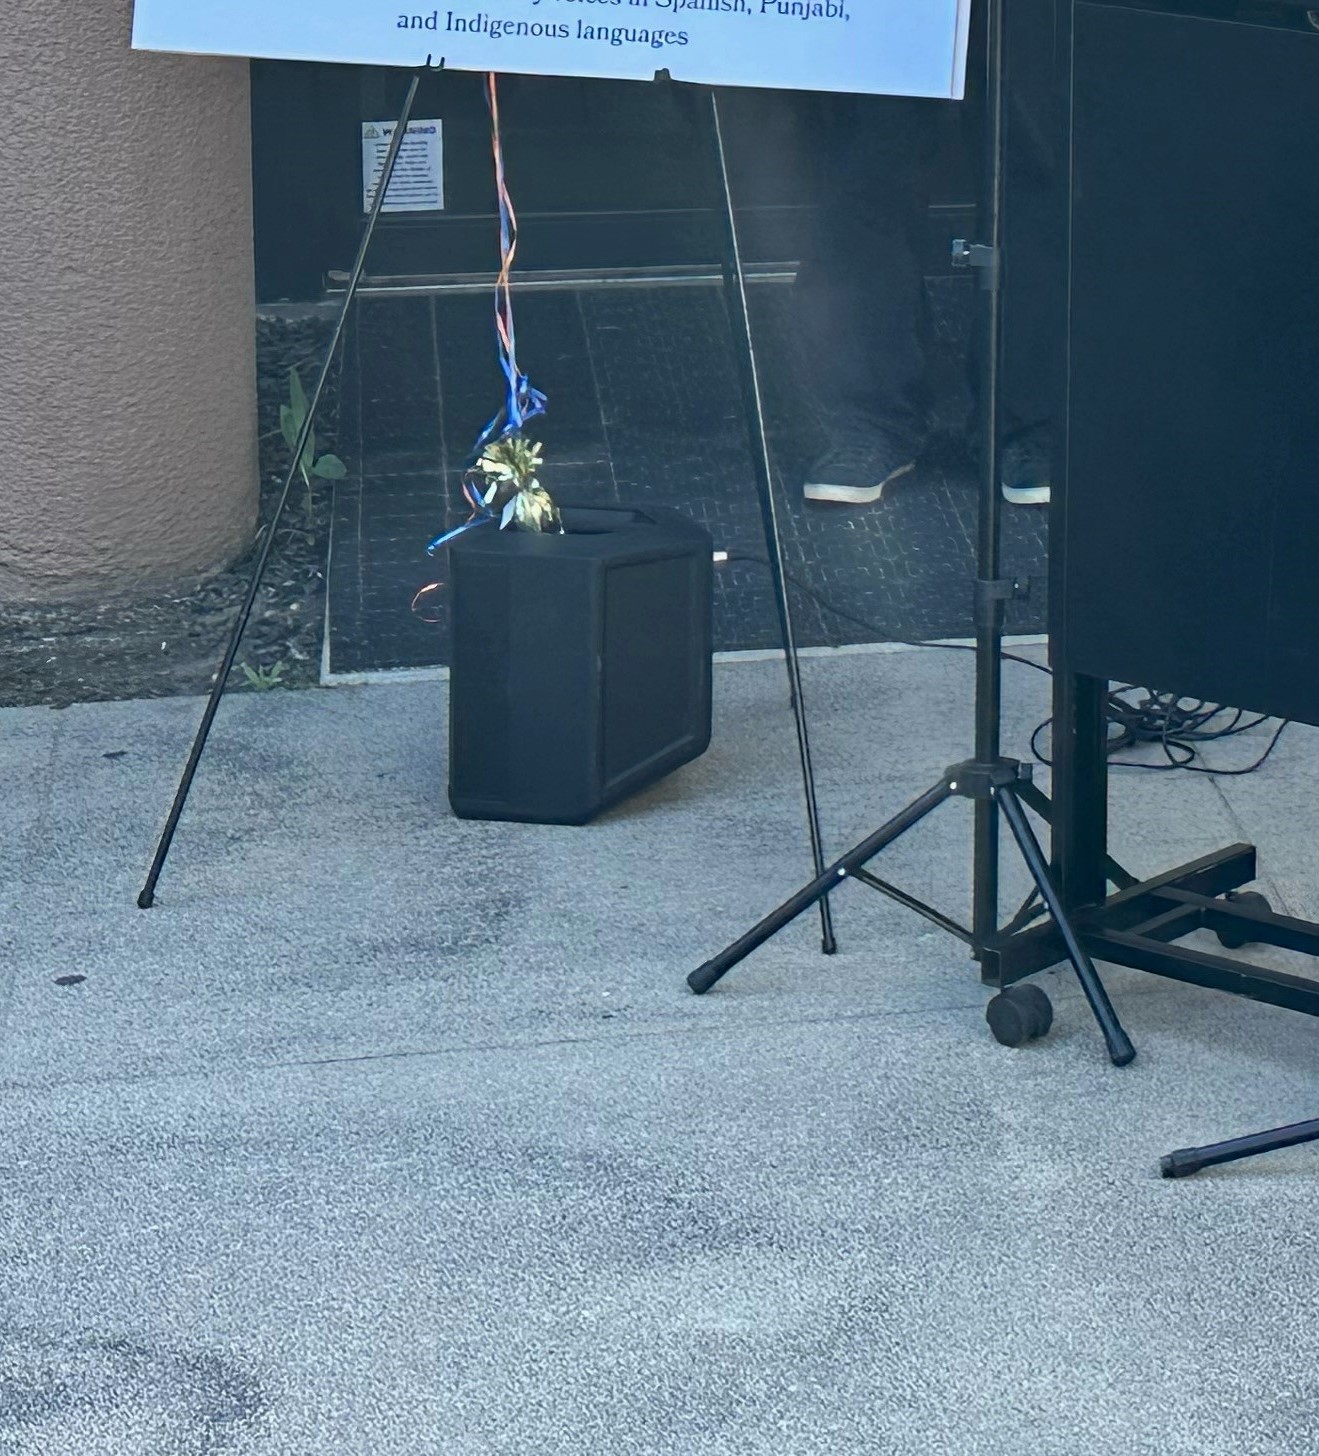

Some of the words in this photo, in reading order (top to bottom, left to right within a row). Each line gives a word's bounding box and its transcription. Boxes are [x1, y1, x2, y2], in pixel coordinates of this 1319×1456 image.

[397, 11, 437, 30] and
[446, 11, 569, 40] Indigenous
[577, 20, 689, 48] languages
